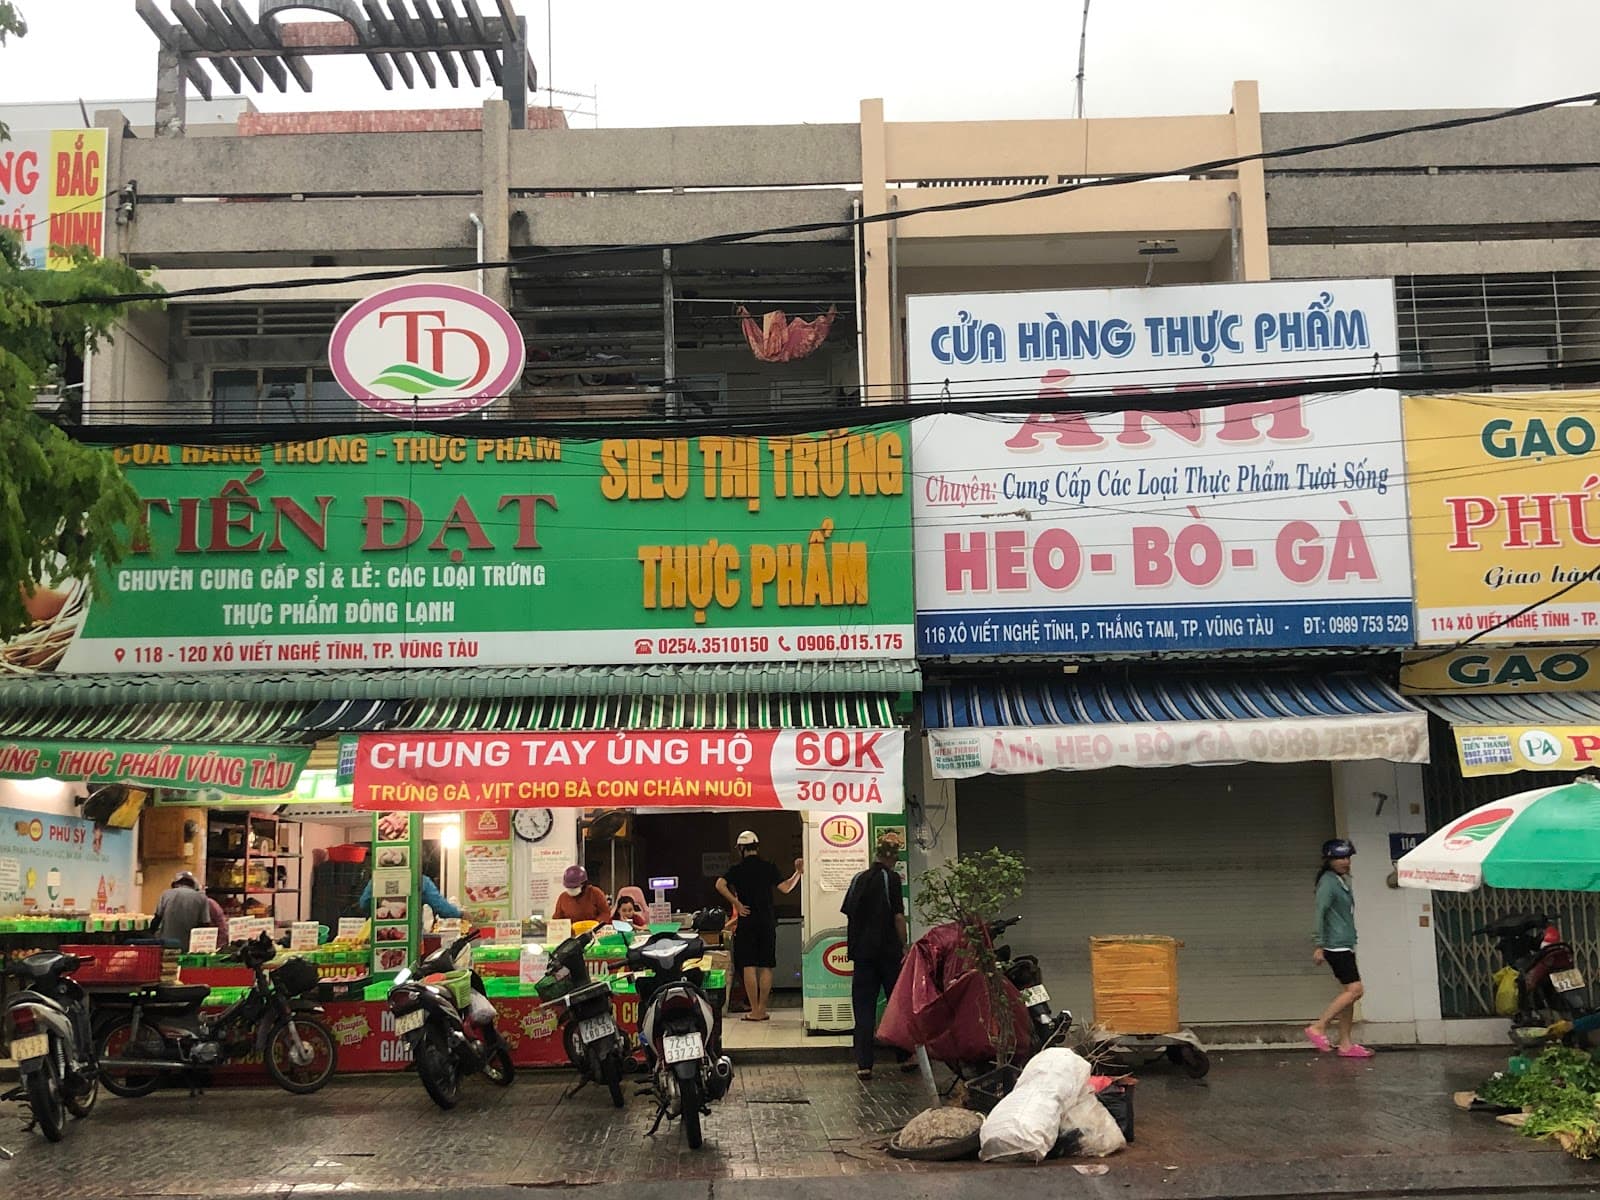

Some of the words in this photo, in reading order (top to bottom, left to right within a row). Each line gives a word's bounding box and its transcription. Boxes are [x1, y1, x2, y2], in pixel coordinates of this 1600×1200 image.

[56, 133, 99, 197] BẮC
[48, 211, 103, 258] NINH
[930, 310, 1006, 363] CỬA
[1017, 312, 1136, 362] HÀNG
[1145, 308, 1243, 366] THỰC
[1254, 291, 1370, 353] PHẨM
[379, 310, 491, 391] TD
[393, 434, 467, 470] THỰC
[1482, 417, 1596, 460] GẠO
[698, 436, 761, 512] THỊ
[925, 474, 998, 507] Chuyên:
[1002, 472, 1050, 504] Cung
[1055, 466, 1091, 504] Cấp
[1097, 467, 1132, 497] Các
[1136, 467, 1179, 500] Loại
[1185, 466, 1231, 499] Thực
[1236, 459, 1290, 494] Phẩm
[1295, 462, 1337, 491] Tươi
[1342, 457, 1389, 495] Sống
[130, 467, 336, 554] TIẾN
[360, 493, 560, 564] ĐẠT
[944, 529, 1082, 591] HEO
[1132, 505, 1223, 586] BÒ
[1275, 500, 1378, 584] GÀ
[118, 563, 193, 592] CHUYÊN
[200, 568, 253, 591] CUNG
[260, 560, 299, 590] CẤP
[330, 566, 344, 588] &
[351, 560, 381, 588] LẺ:
[387, 560, 426, 588] CÁC
[432, 565, 476, 592] LOẠI
[481, 560, 547, 587] TRỨNG
[637, 537, 742, 624] THỰC
[750, 517, 869, 608] PHẨM
[1485, 566, 1541, 586] Giao
[1551, 565, 1600, 583] hàn
[223, 601, 272, 630] THỰC
[279, 594, 338, 624] PHẨM
[344, 597, 399, 624] ĐÔNG
[405, 600, 456, 627] LẠNH
[924, 627, 946, 643] 116
[949, 624, 968, 643] XÔ
[970, 620, 999, 642] VIẾT
[1003, 620, 1042, 645] NGHỆ
[1045, 618, 1078, 640] TĨNH,
[1082, 620, 1094, 637] P.
[1098, 613, 1144, 637] THẮNG
[1148, 618, 1179, 638] TAM,
[1182, 617, 1202, 635] TP.
[1206, 613, 1243, 635] VŨNG
[1248, 611, 1274, 635] TÀU
[1303, 615, 1325, 634] ĐT:
[1329, 613, 1358, 633] 0989
[1362, 614, 1385, 632] 753
[1387, 613, 1409, 632] 529
[1431, 618, 1453, 630] 114
[1457, 612, 1473, 630] XÔ
[1477, 610, 1502, 629] VIẾT
[1505, 612, 1539, 630] NGHỆ
[1542, 611, 1570, 627] TĨNH
[1582, 612, 1598, 625] TP.
[134, 646, 163, 663] 118
[179, 646, 207, 663] 120
[212, 642, 235, 663] XÔ
[239, 637, 273, 661] VIẾT
[278, 641, 324, 664] NGHỆ
[327, 640, 370, 663] TĨNH,
[373, 644, 395, 660] TP.
[400, 640, 443, 659] VŨNG
[449, 637, 479, 658] TÀU
[658, 637, 770, 654] 0254.3510150
[796, 634, 903, 651] 0906.015.175
[1448, 654, 1588, 686] GẠO
[369, 738, 511, 770] CHUNG
[521, 738, 597, 767] TAY
[605, 733, 691, 765] ỦNG
[700, 736, 753, 766] HỘ
[794, 730, 885, 769] 60K
[1055, 732, 1112, 763] HEO
[1133, 727, 1174, 761] BÒ
[1200, 724, 1236, 760] GÀ
[1248, 730, 1320, 758] 0989
[1526, 736, 1557, 757] PA
[57, 750, 114, 781] THỰC
[117, 746, 182, 779] PHẨM
[188, 754, 243, 788] VŨNG
[251, 753, 295, 790] TÀU
[369, 780, 438, 802] TRỨNG
[443, 781, 471, 801] GÀ
[518, 782, 560, 800] CHO
[565, 778, 592, 799] BÀ
[596, 781, 639, 799] CON
[643, 778, 700, 798] CHĂN
[705, 778, 753, 798] NUÔI
[796, 783, 823, 801] 30
[831, 778, 883, 805] QUẢ
[1400, 837, 1416, 850] 114
